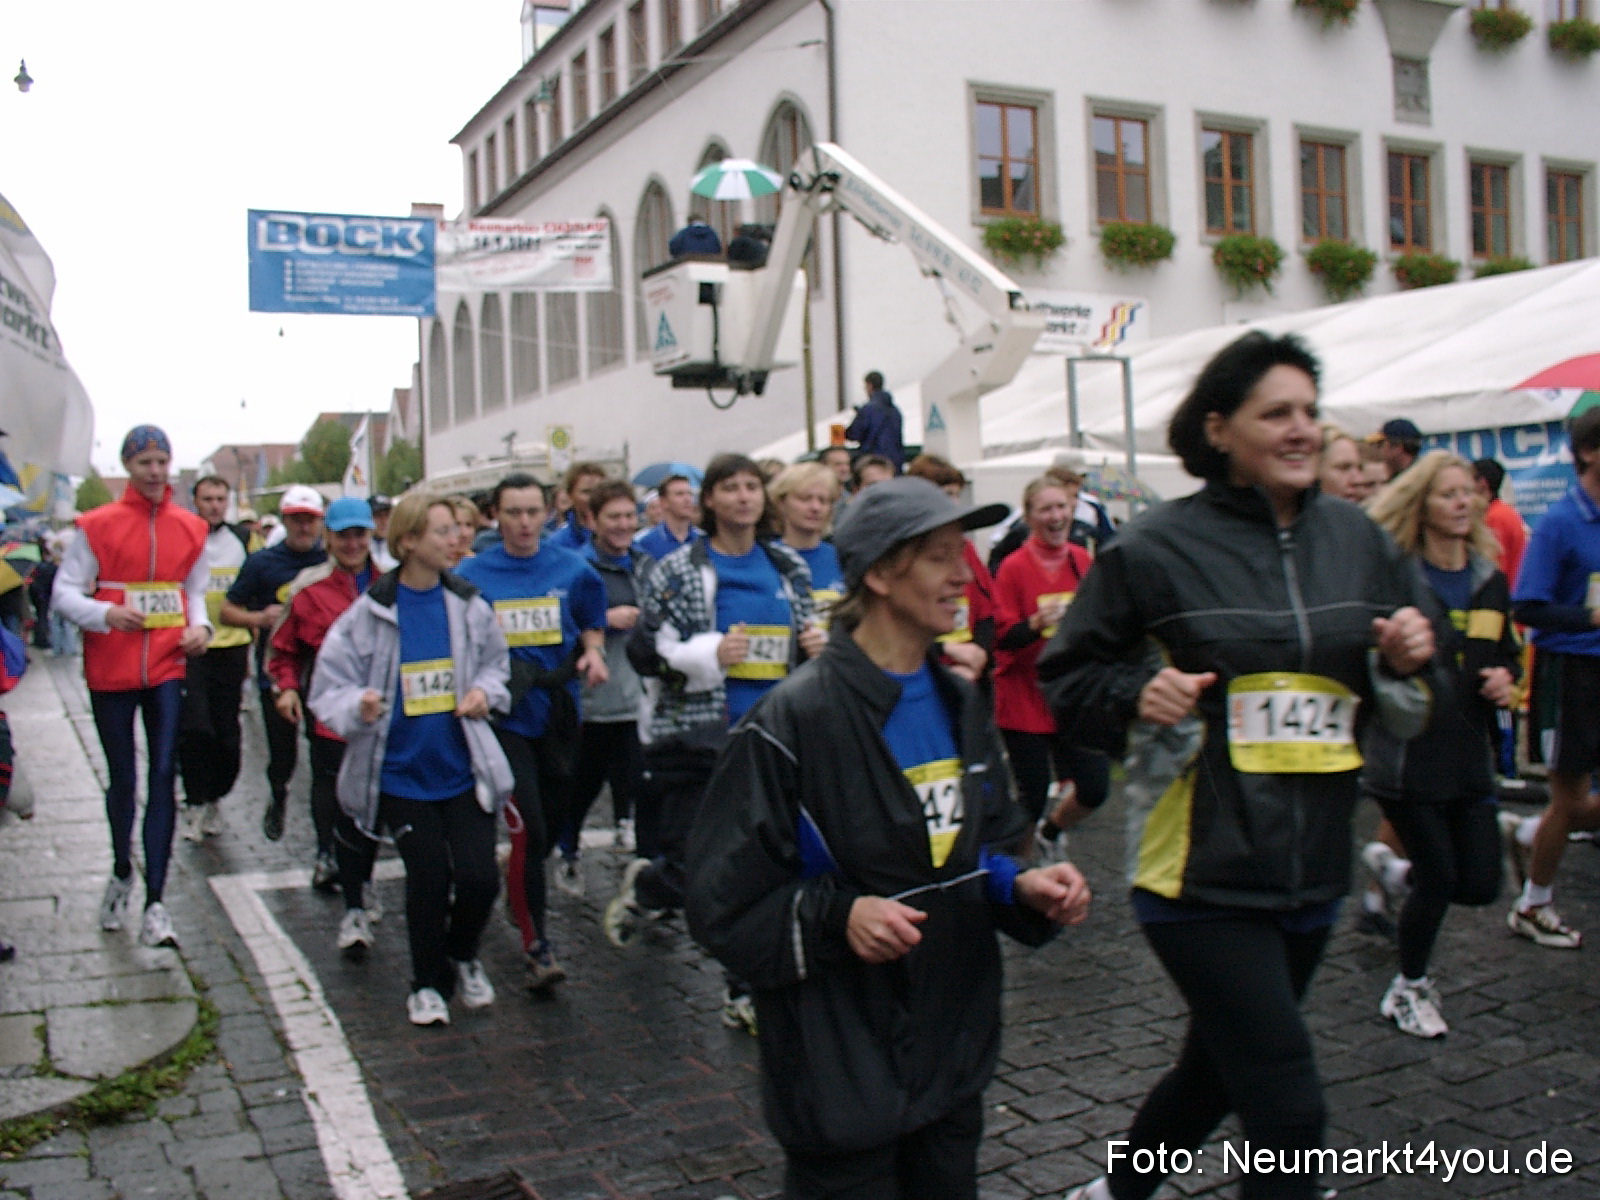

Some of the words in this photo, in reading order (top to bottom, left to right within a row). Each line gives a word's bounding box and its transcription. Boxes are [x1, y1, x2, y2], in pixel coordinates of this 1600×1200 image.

[258, 215, 424, 256] BOCK
[510, 609, 552, 629] 1761
[1257, 696, 1341, 736] 1424
